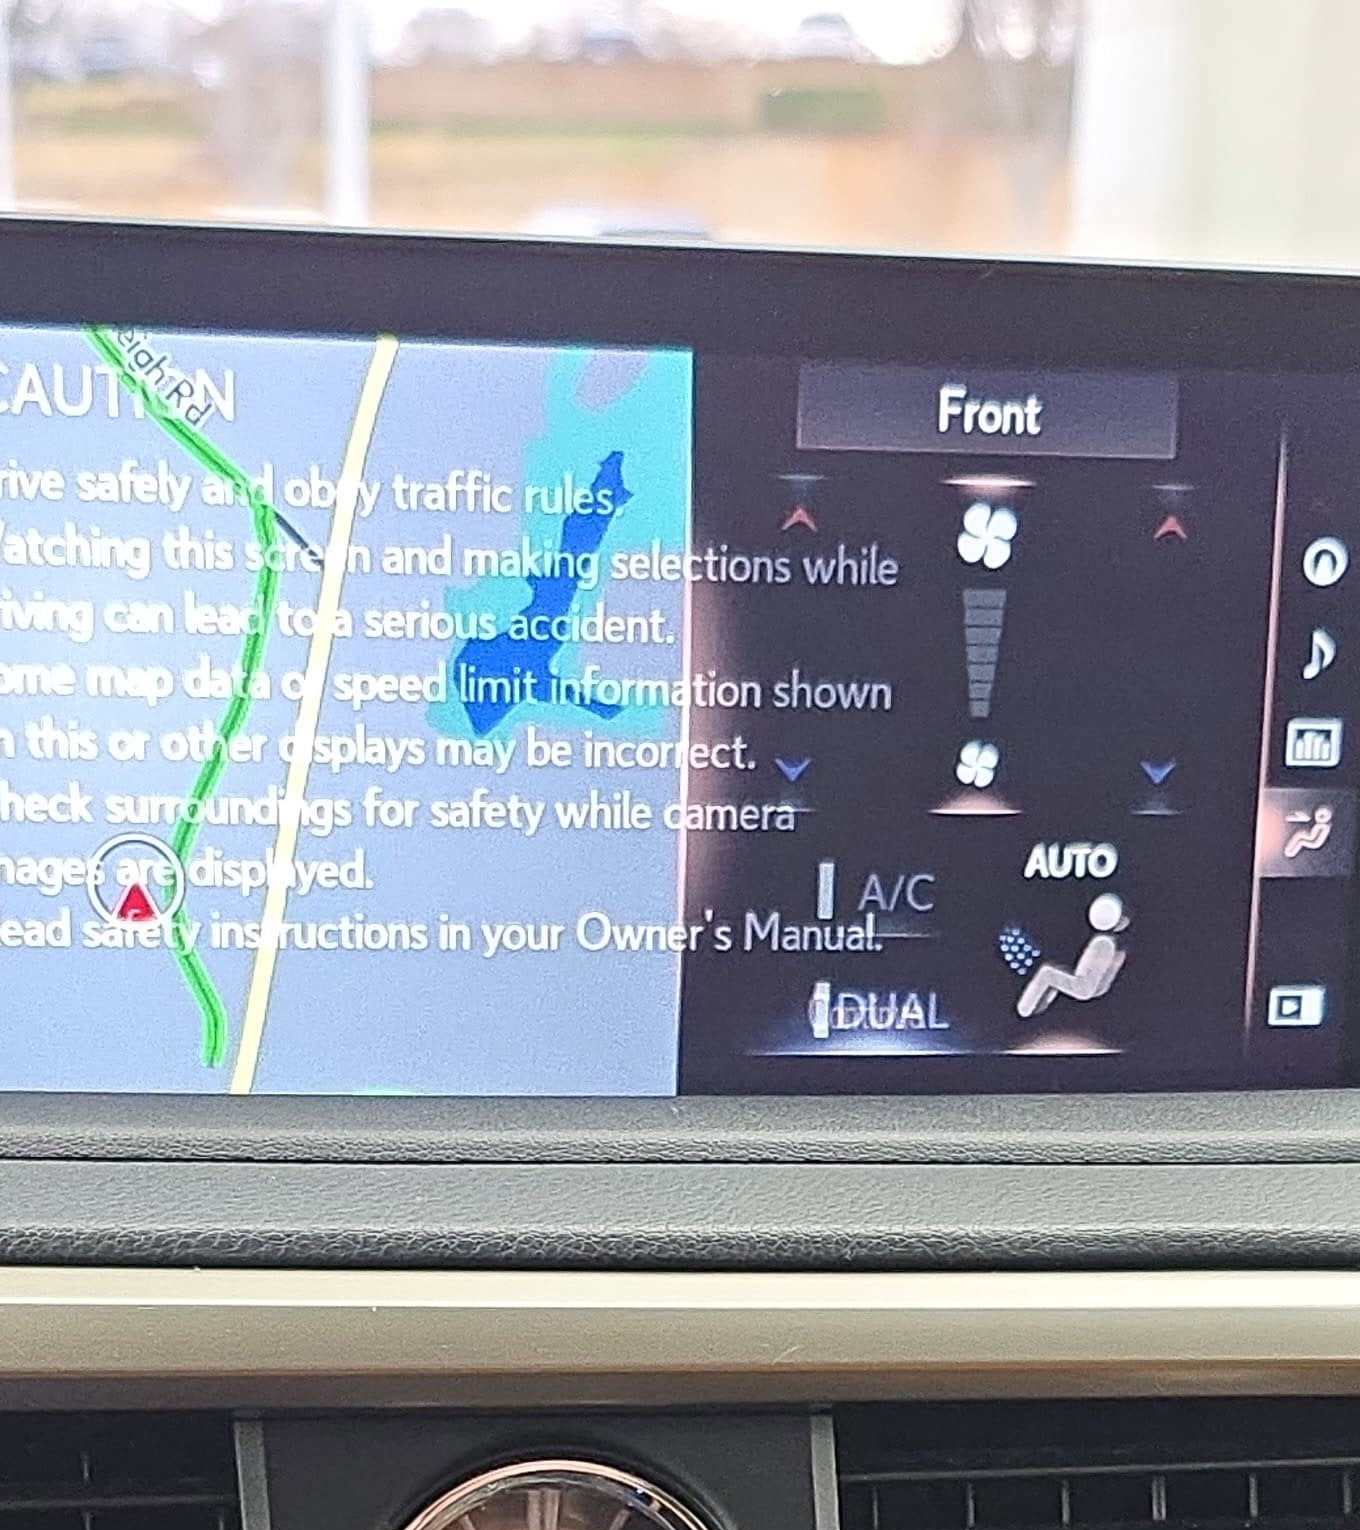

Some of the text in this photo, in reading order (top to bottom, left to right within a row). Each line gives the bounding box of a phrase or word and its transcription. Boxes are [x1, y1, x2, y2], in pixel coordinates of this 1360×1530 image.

[166, 379, 213, 427] Rd
[938, 384, 1042, 436] Front
[77, 459, 191, 512] safely
[284, 464, 381, 518] oby
[392, 470, 512, 513] traffic
[524, 479, 625, 517] rules.
[161, 525, 235, 570] this
[244, 541, 371, 575] scren
[382, 534, 451, 576] and
[463, 538, 600, 590] making
[609, 542, 791, 585] selections
[802, 543, 899, 587] while
[103, 601, 175, 634] can
[184, 590, 266, 636] lead
[276, 599, 317, 638] to
[332, 608, 353, 638] a
[363, 601, 498, 642] serious
[507, 608, 676, 646] accident.
[86, 664, 174, 706] map
[183, 651, 271, 700] data
[281, 670, 320, 701] o
[334, 658, 447, 709] speed
[458, 664, 538, 705] limit
[549, 666, 762, 710] information
[773, 667, 893, 710] shown
[25, 714, 98, 762] this
[107, 731, 151, 763] or
[160, 720, 268, 763] other
[278, 722, 425, 774] dsplays
[436, 737, 516, 771] may
[525, 731, 572, 768] be
[583, 734, 758, 772] incorrect.
[362, 786, 419, 830] for
[430, 790, 548, 838] safety
[554, 792, 653, 832] while
[663, 802, 797, 834] camera
[116, 857, 177, 886] are
[1024, 842, 1120, 880] AUTO
[857, 873, 936, 913] A/C
[82, 909, 201, 955] safety
[211, 912, 428, 951] insructions
[439, 914, 472, 951] in
[483, 919, 564, 958] your
[576, 912, 733, 954] Owner's
[742, 911, 885, 954] Manual.
[837, 991, 951, 1030] DUAL
